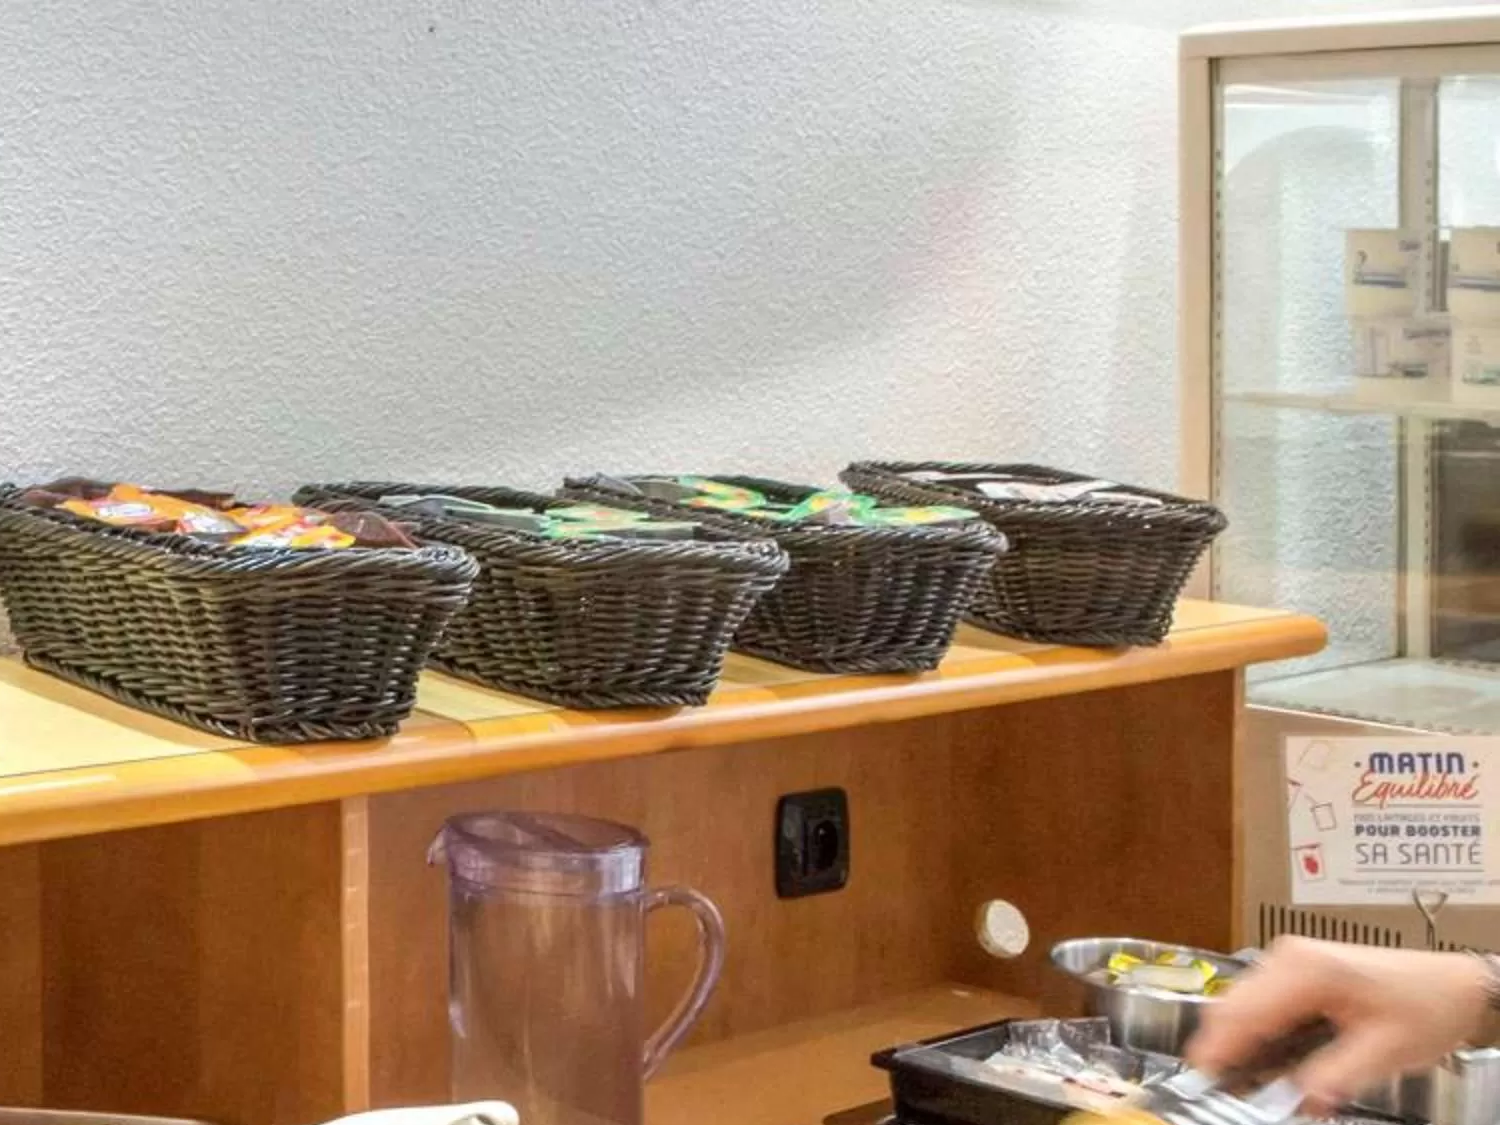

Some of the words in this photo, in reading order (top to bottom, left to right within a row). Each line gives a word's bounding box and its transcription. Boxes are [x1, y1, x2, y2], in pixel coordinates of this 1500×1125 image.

[1368, 752, 1465, 774] MATIN
[1355, 825, 1400, 837] POUR
[1406, 825, 1481, 837] BOOSTER
[1355, 843, 1388, 865] SA
[1398, 839, 1482, 865] SANTÉ
